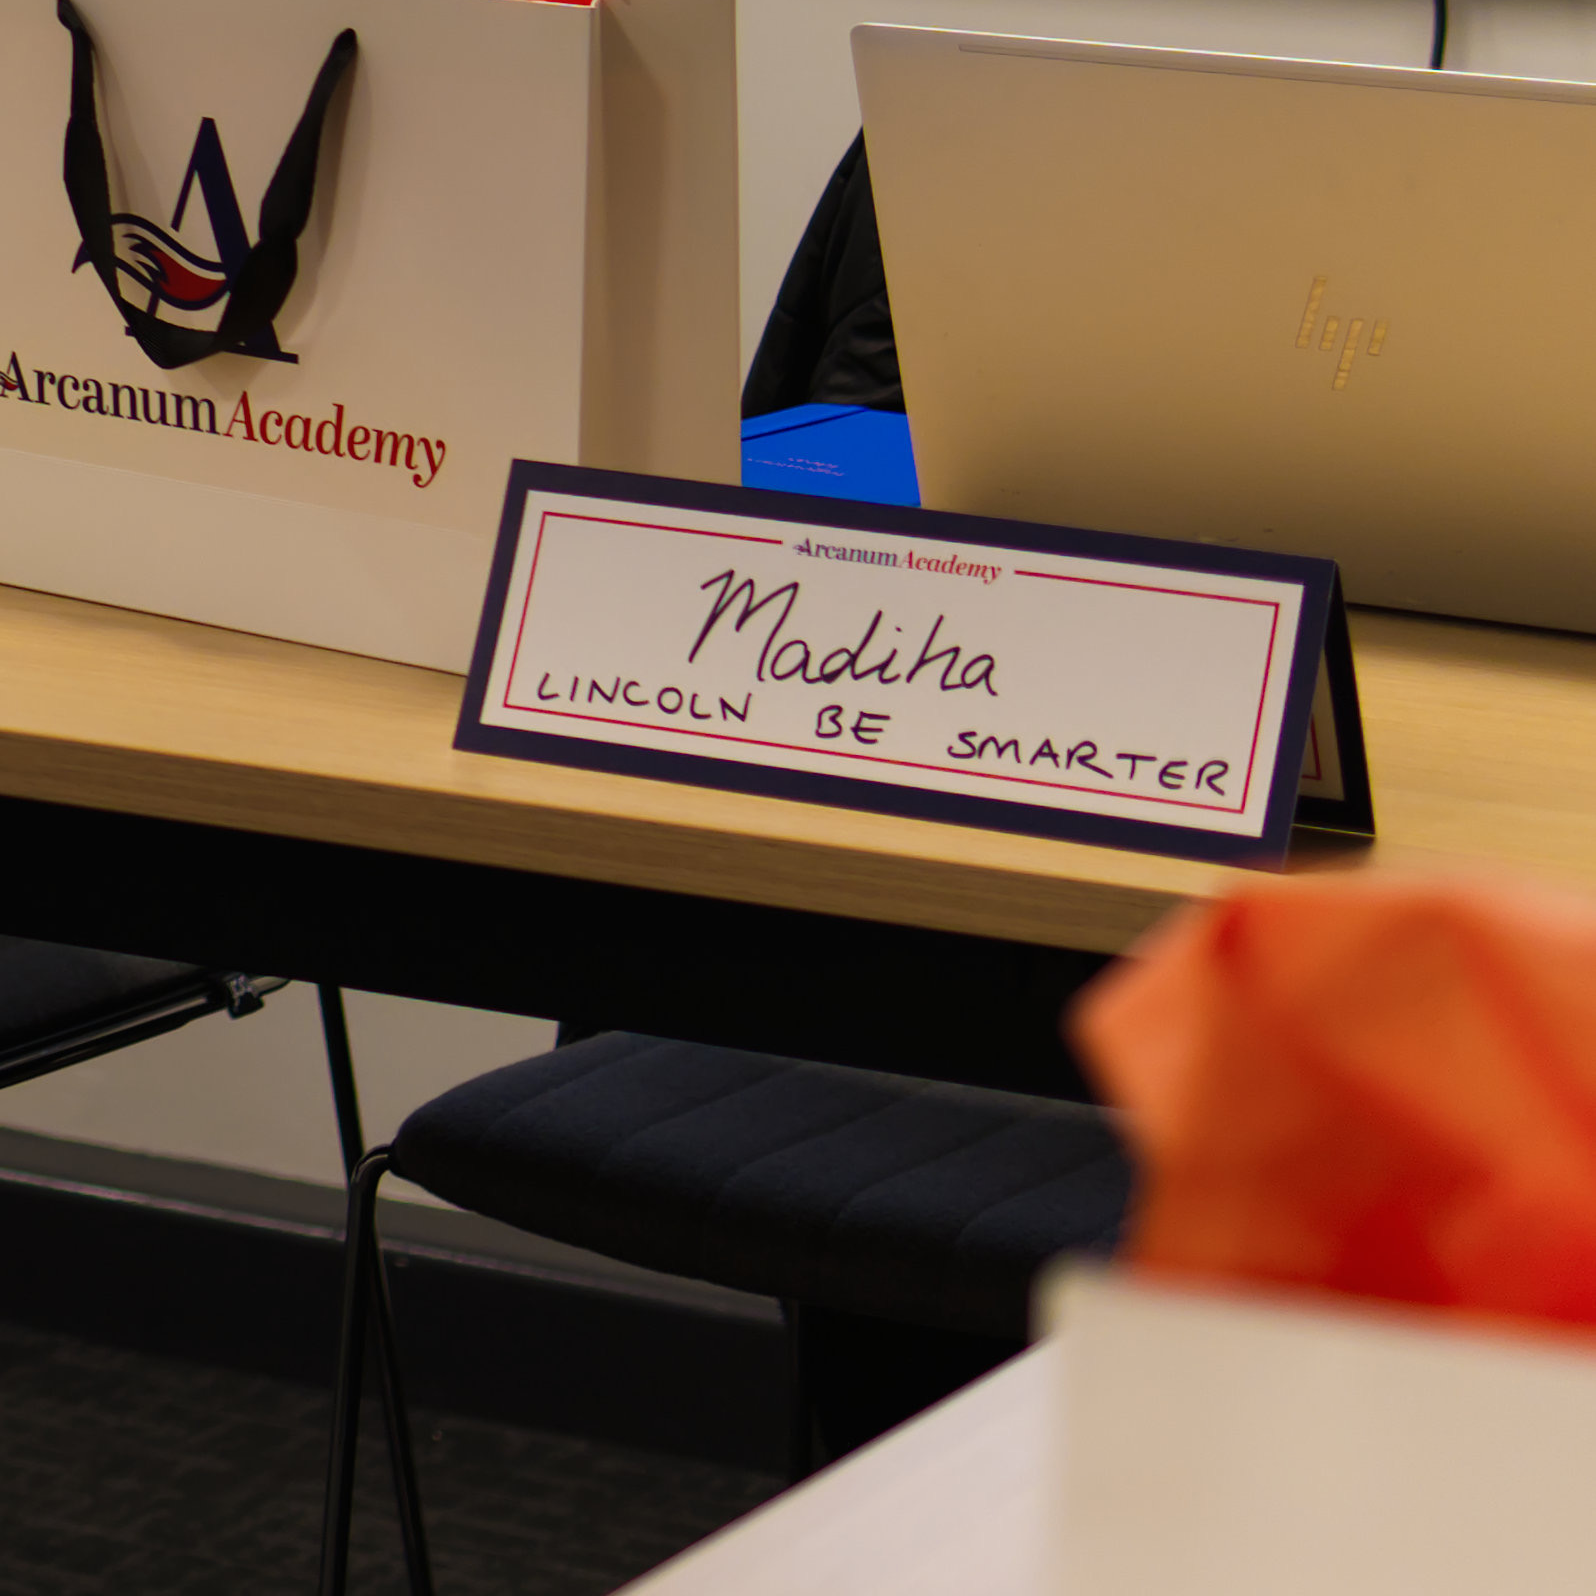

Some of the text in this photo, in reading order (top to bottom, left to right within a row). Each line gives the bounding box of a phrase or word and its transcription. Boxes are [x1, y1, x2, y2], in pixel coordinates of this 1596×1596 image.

[223, 390, 447, 488] Academy
[792, 536, 1003, 584] Arcanum Academy
[686, 569, 999, 697] Madiha
[536, 672, 1231, 796] LINCOLN BE SMARTER
